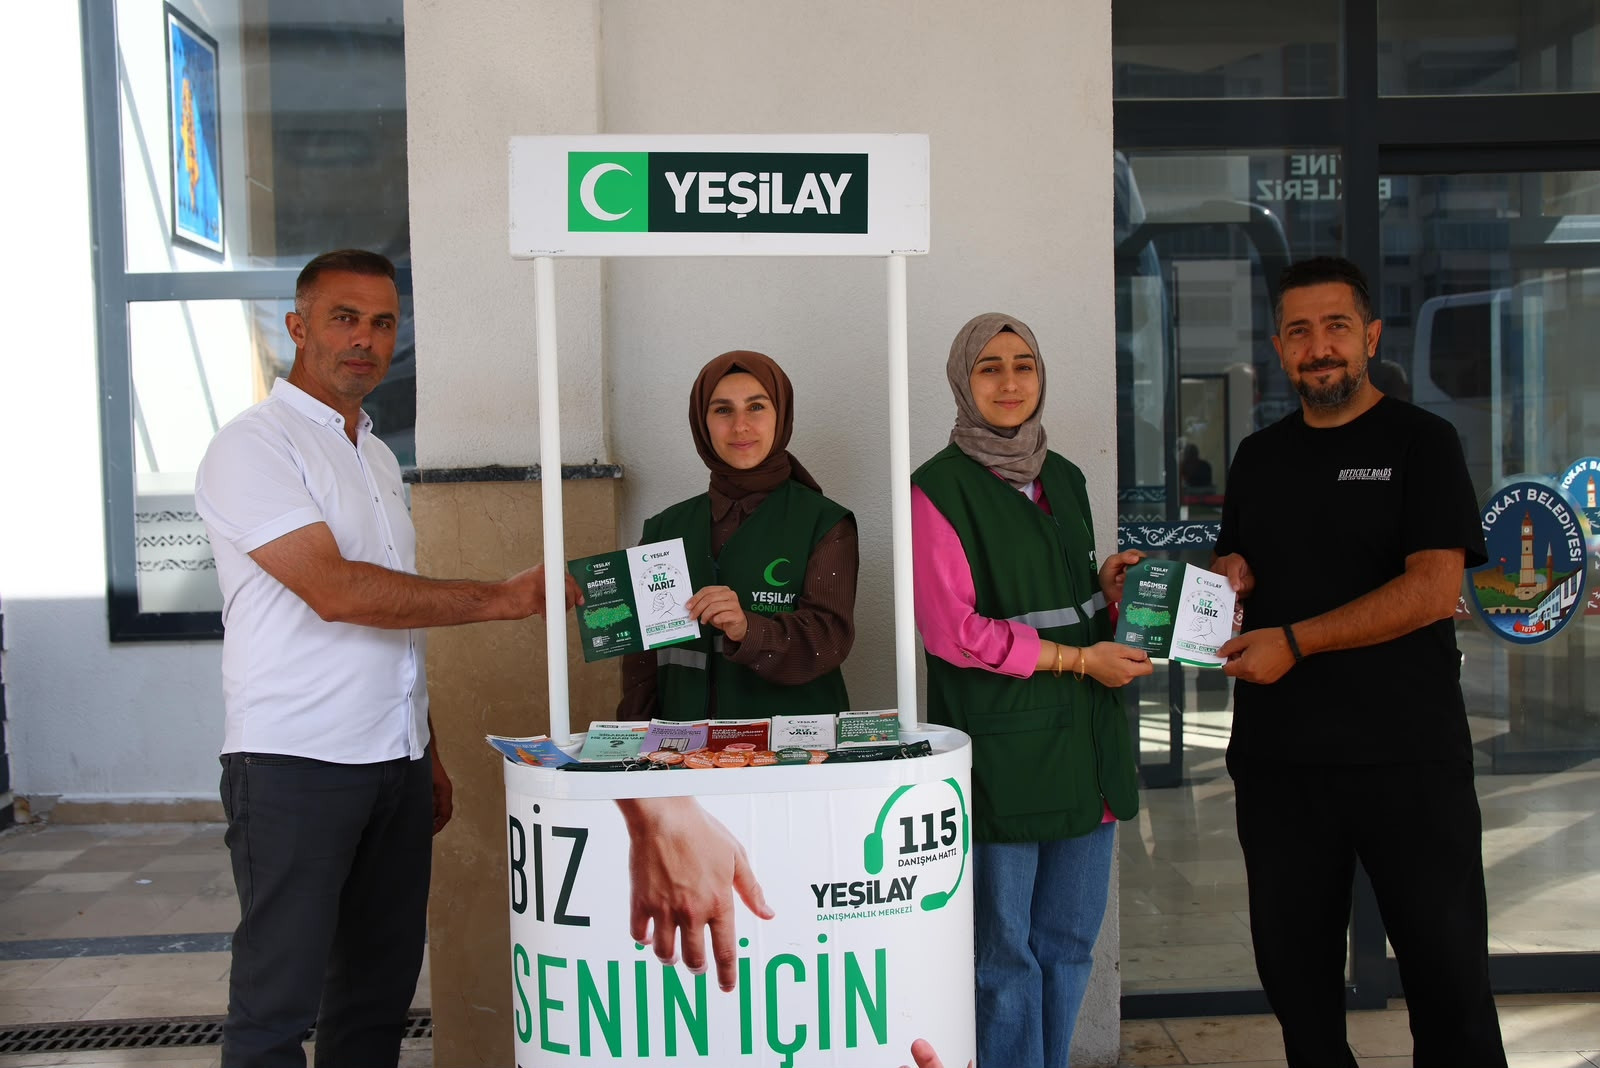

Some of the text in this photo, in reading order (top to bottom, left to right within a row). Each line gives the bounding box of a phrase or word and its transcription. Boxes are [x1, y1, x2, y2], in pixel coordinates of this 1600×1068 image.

[1482, 489, 1521, 531] TOKAT
[648, 579, 676, 592] VARIZ
[1192, 604, 1218, 618] VARIZ
[1521, 625, 1536, 633] 1870
[899, 807, 957, 855] 115
[509, 803, 591, 927] BİZ
[898, 848, 957, 868] DANIŞMA HATTI
[816, 910, 877, 922] DANIŞMANLIK
[513, 934, 888, 1068] SENİN İÇİN
